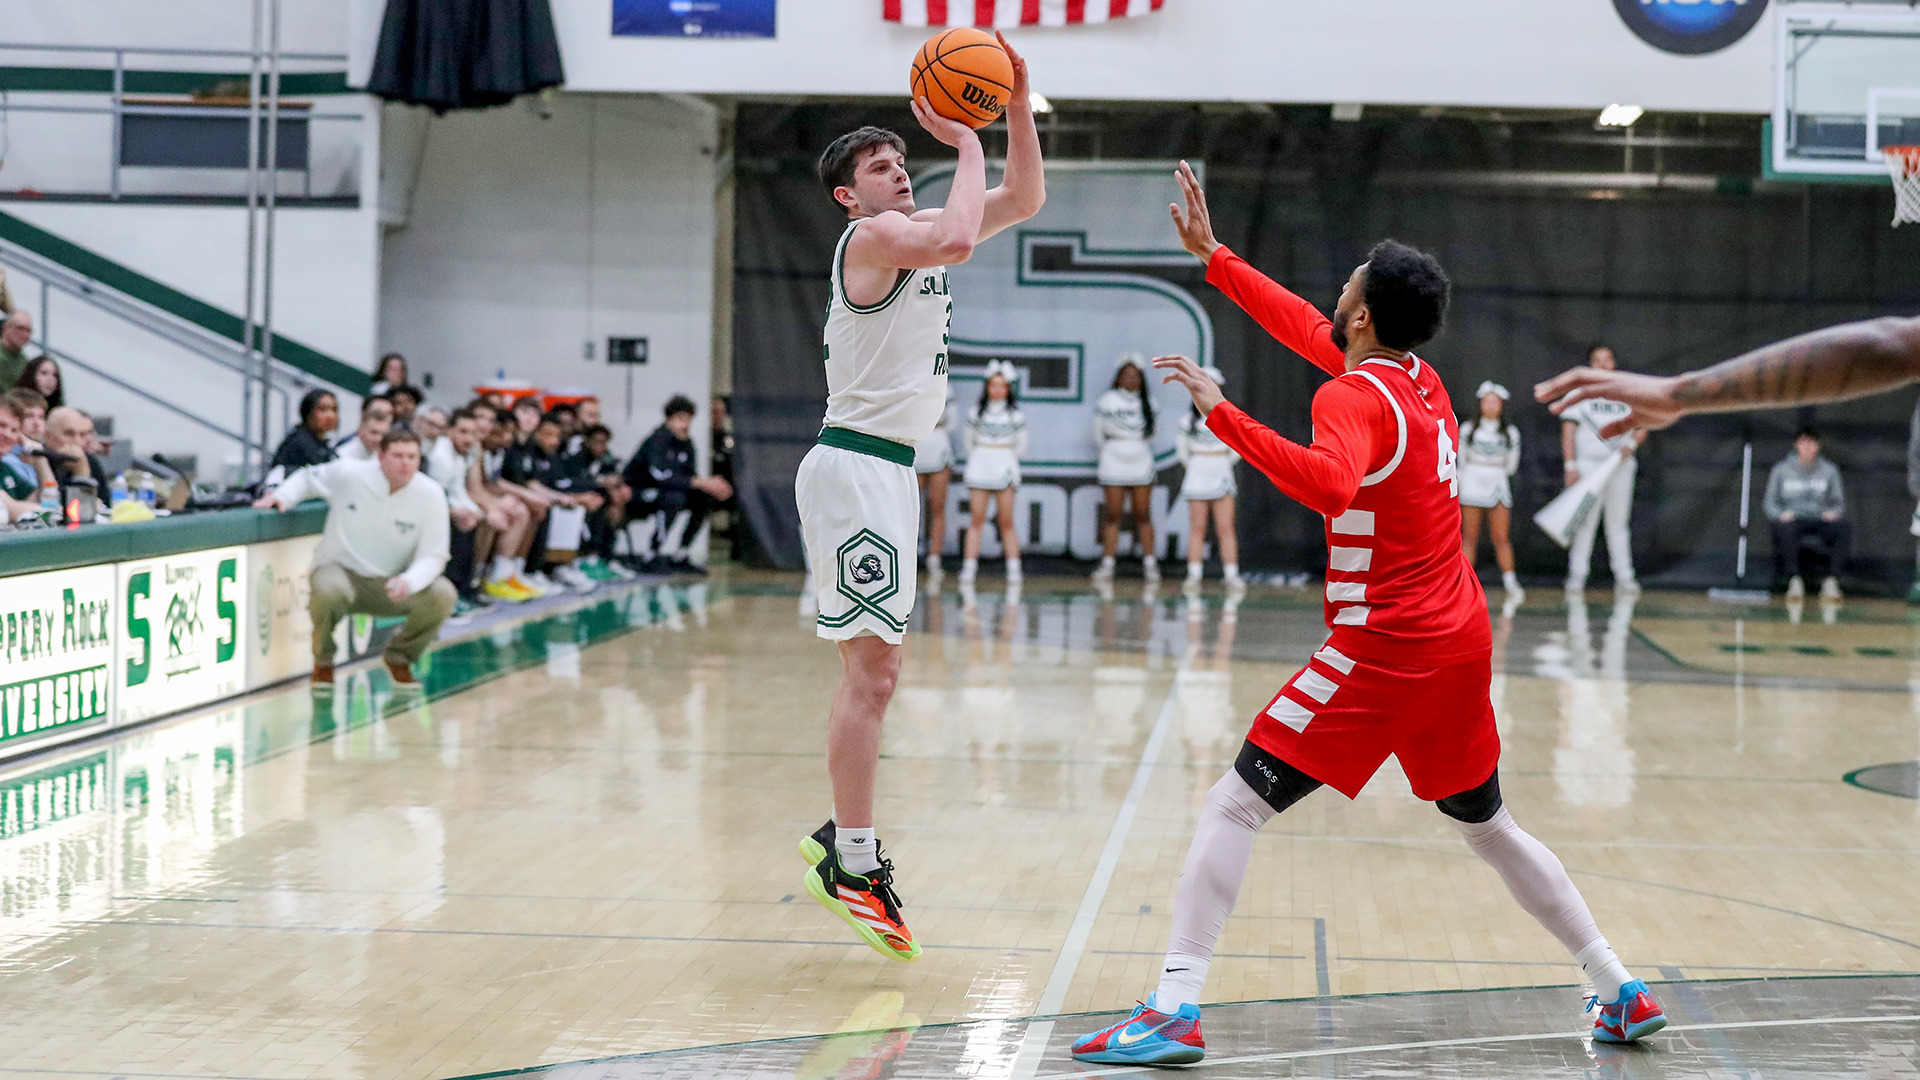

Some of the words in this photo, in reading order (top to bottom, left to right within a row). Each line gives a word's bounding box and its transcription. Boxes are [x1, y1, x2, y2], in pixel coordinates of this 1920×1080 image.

[1437, 418, 1459, 499] 4
[126, 571, 151, 688] S
[216, 558, 237, 664] S
